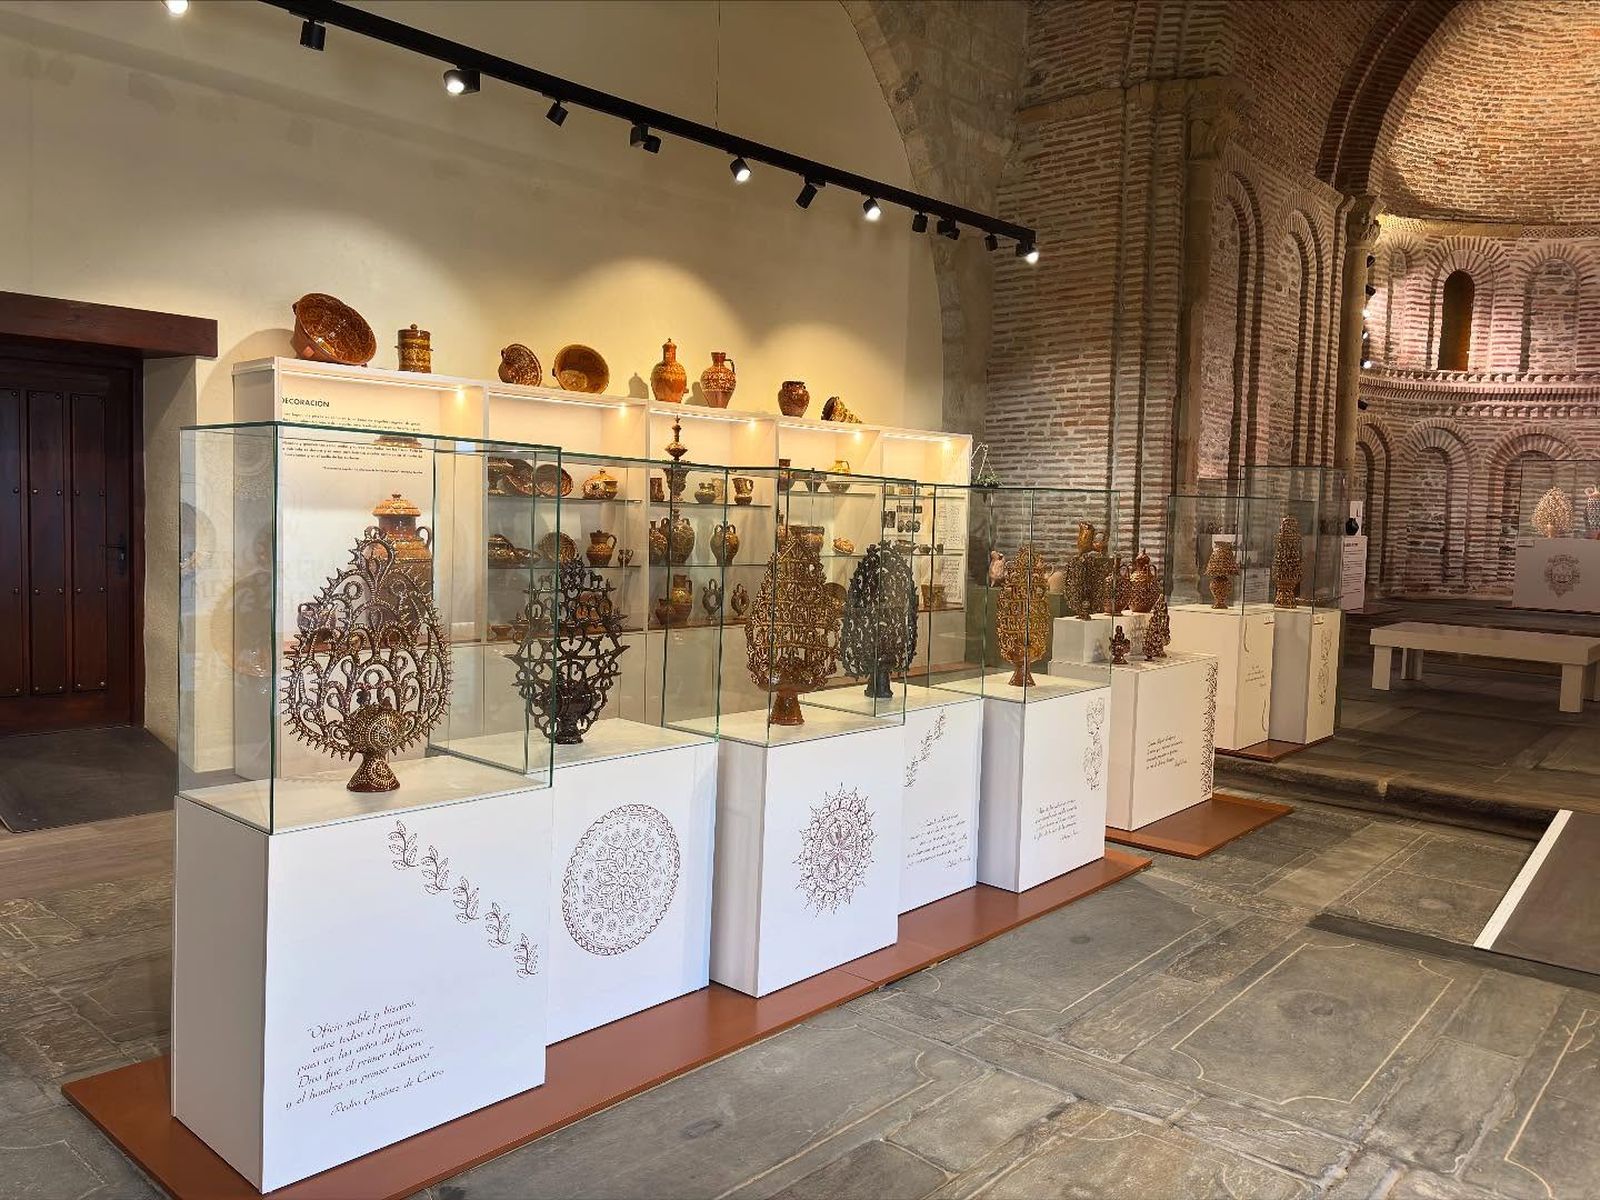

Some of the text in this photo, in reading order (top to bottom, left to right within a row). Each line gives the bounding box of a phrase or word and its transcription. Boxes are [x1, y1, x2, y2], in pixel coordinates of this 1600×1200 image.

[346, 1010, 371, 1028] noble
[312, 1041, 335, 1053] entre
[340, 1029, 364, 1044] todos
[368, 1022, 376, 1035] el
[339, 1048, 352, 1060] las
[356, 1041, 378, 1053] artes
[345, 1058, 355, 1072] el
[404, 1076, 414, 1089] de
[296, 1090, 306, 1104] el
